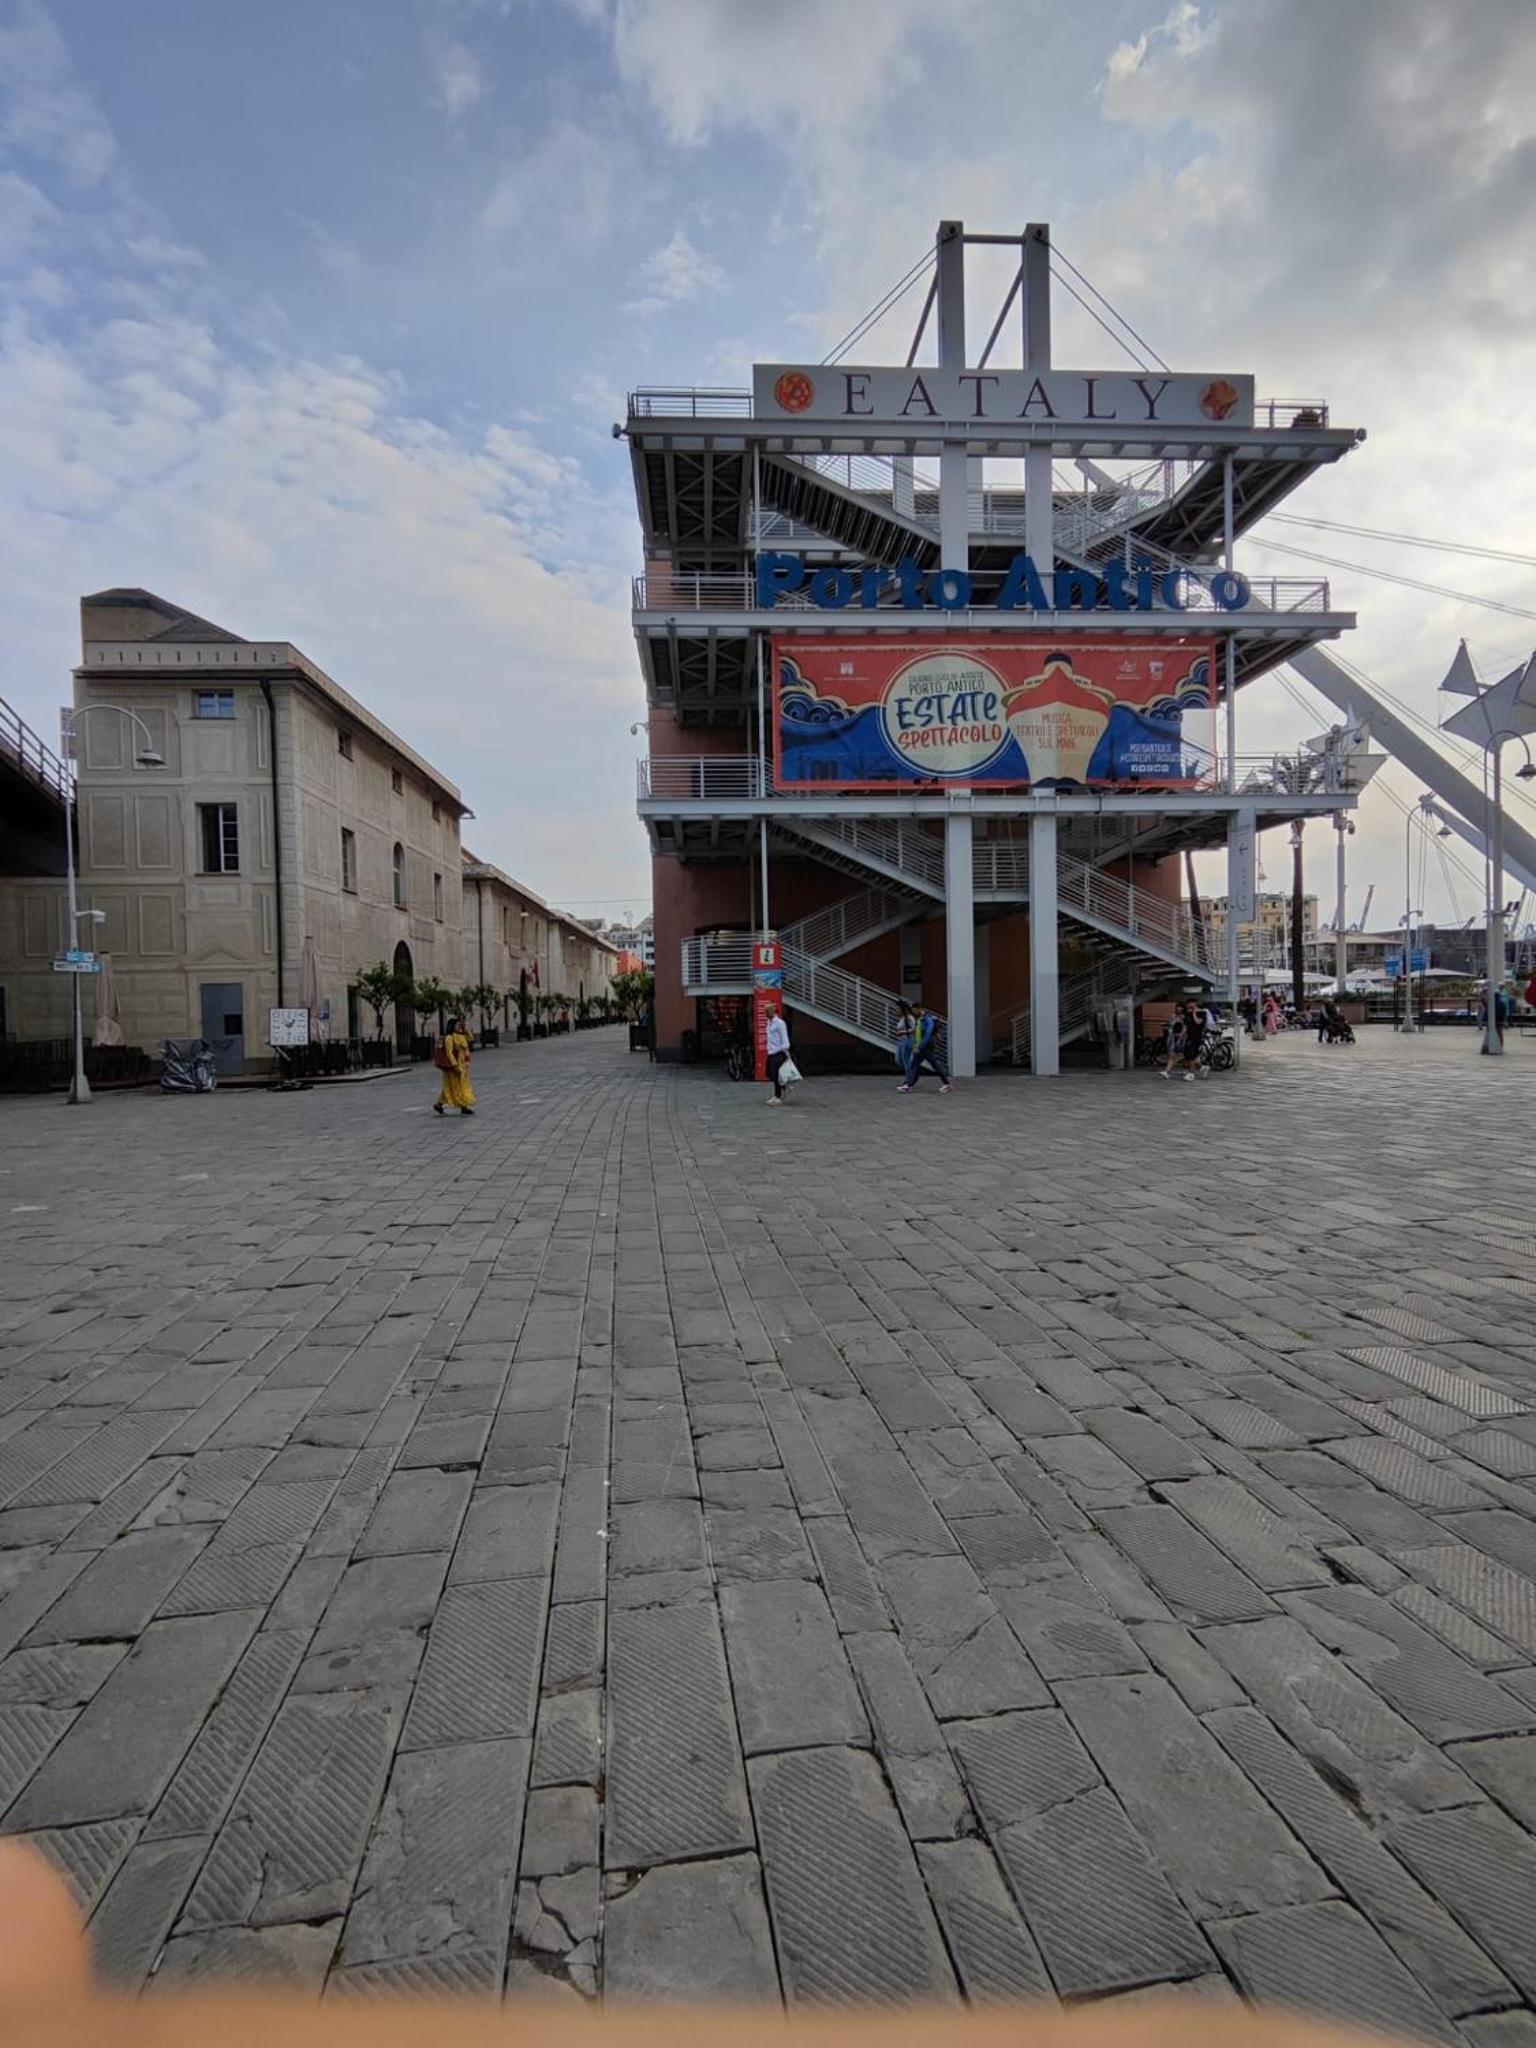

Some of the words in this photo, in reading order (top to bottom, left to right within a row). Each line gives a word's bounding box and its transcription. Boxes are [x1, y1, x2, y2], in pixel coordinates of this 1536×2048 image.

[840, 373, 1175, 420] EATALY
[756, 549, 972, 609] Porto
[997, 552, 1251, 610] Antico
[908, 681, 942, 696] PORTO
[947, 679, 985, 693] ANTICO
